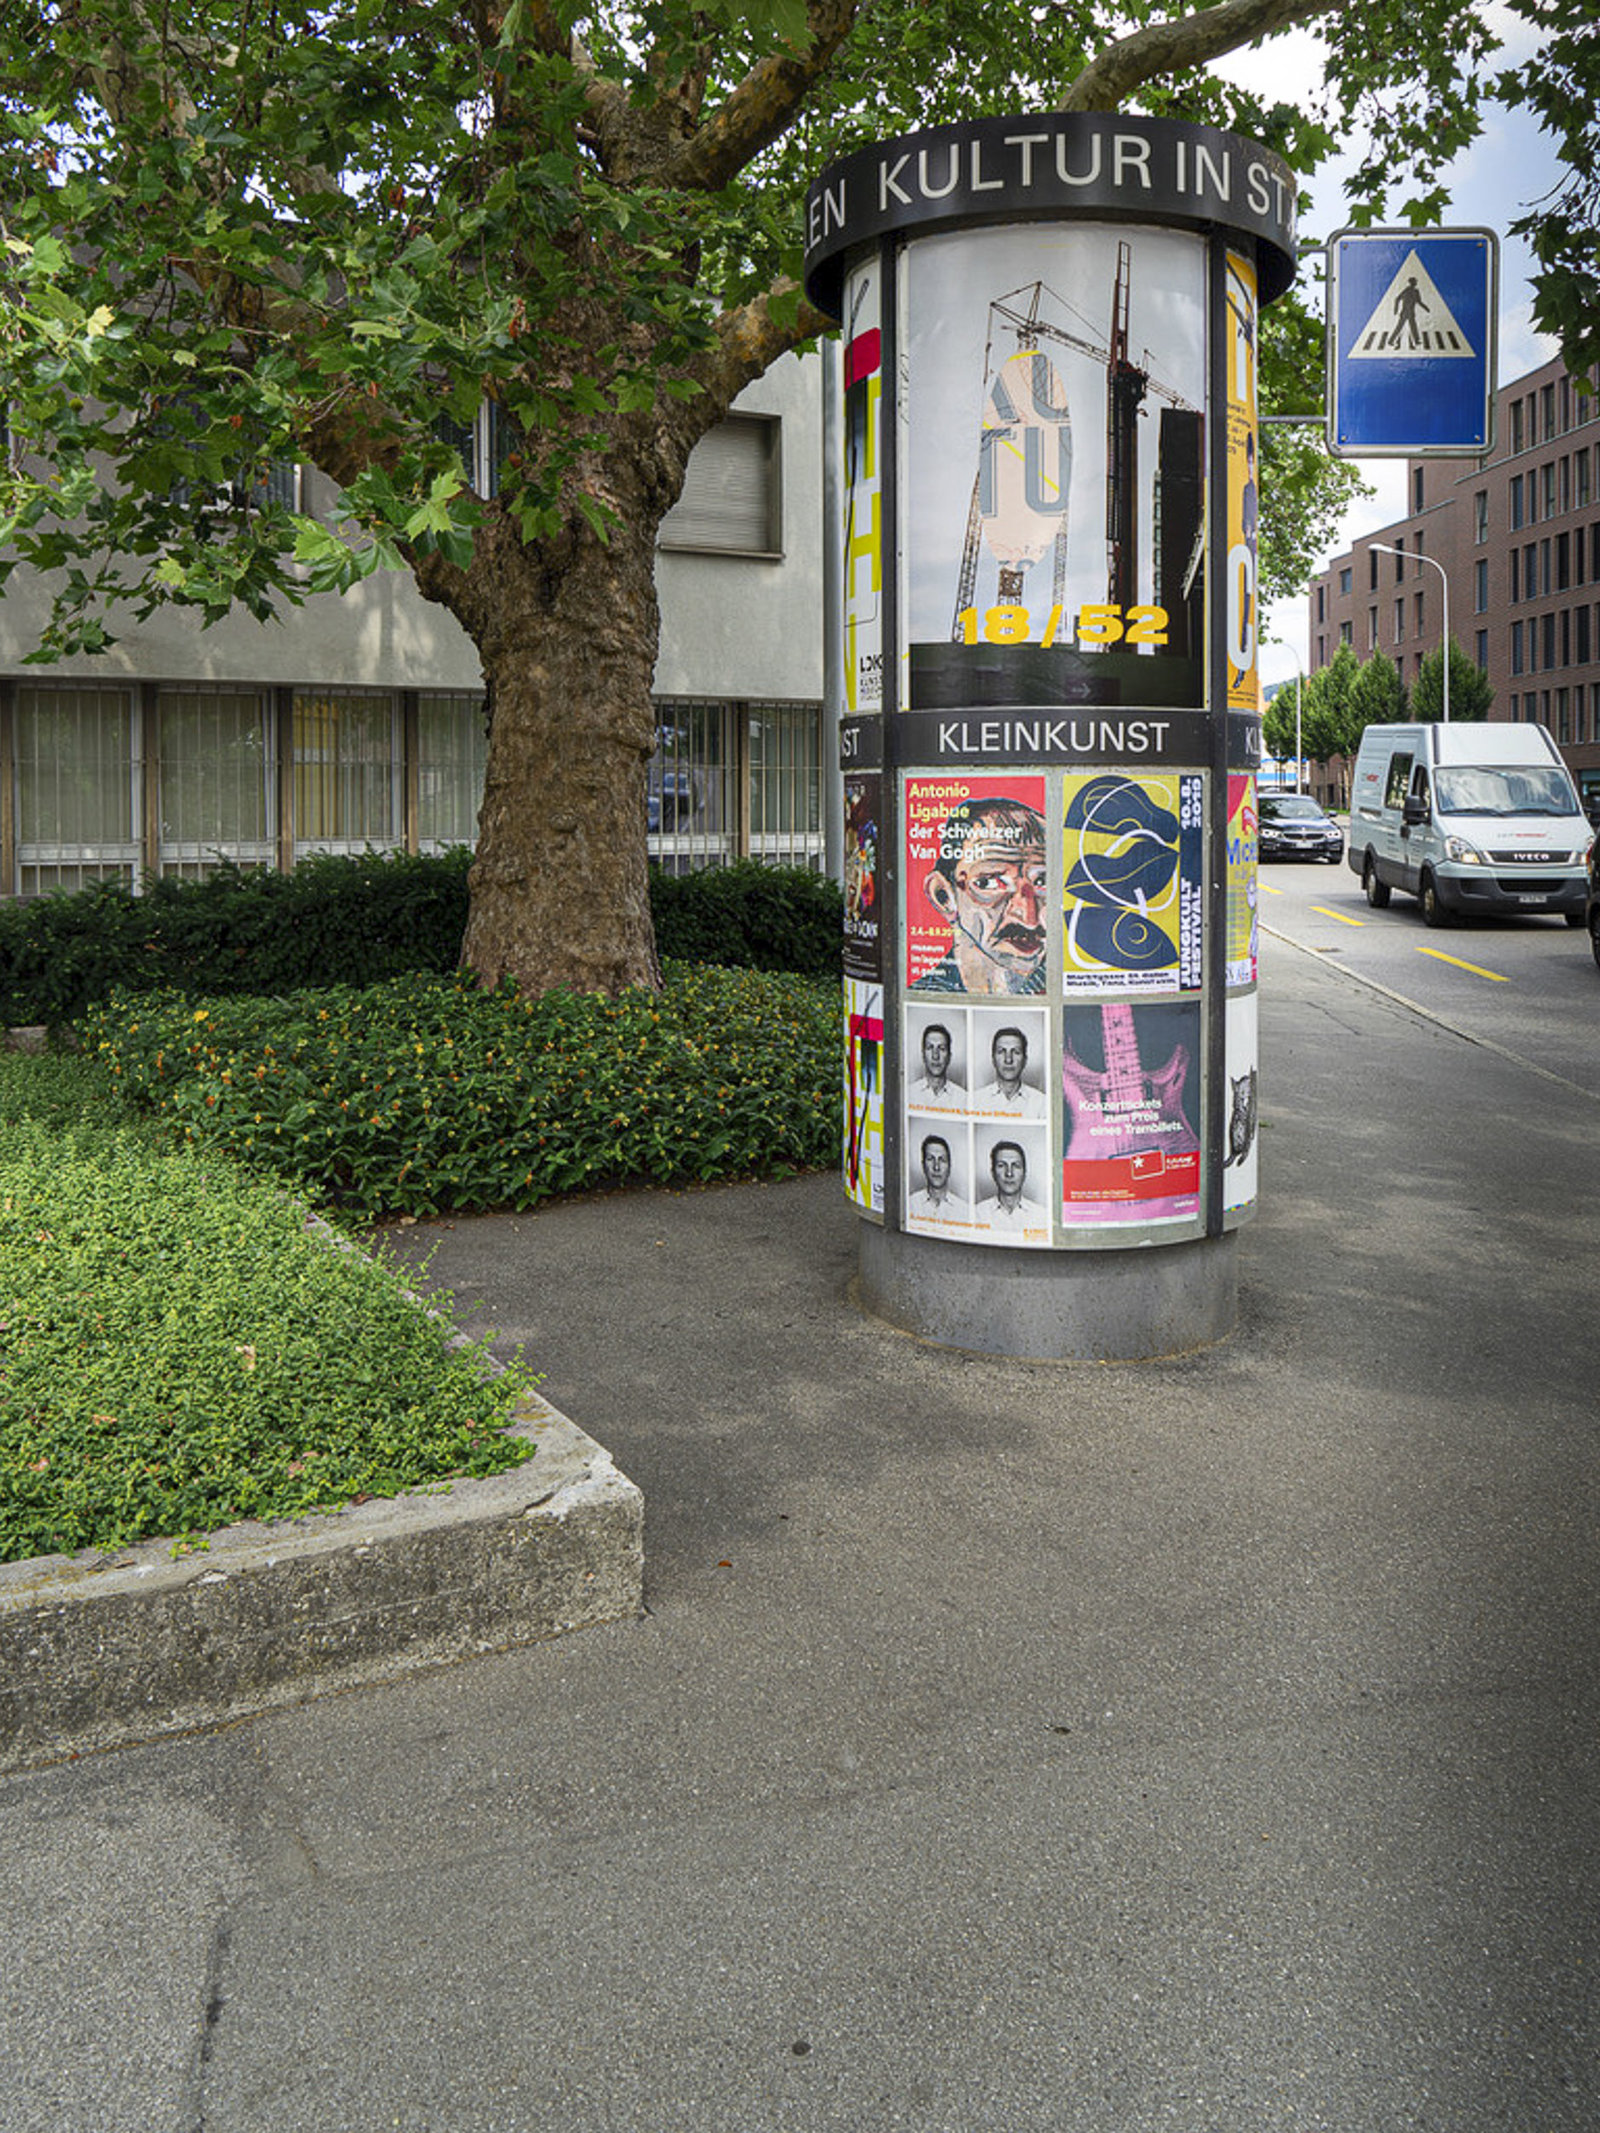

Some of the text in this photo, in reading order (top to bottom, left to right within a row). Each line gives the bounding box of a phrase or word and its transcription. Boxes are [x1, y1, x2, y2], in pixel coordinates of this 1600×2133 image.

[804, 178, 846, 258] EN
[879, 133, 1152, 212] KULTUR
[1176, 141, 1230, 201] IN
[842, 727, 861, 757] ST
[938, 721, 1170, 752] KLEINKUNST
[909, 781, 970, 798] Antonio
[909, 802, 970, 822] Ligabue
[909, 822, 1023, 839] der Schweizer
[909, 843, 985, 863] Van Gogh
[1513, 852, 1551, 861] IVECO
[1181, 877, 1192, 987] JUNGKULT
[1191, 885, 1202, 987] FESTIVAL
[1131, 1111, 1159, 1122] Preis
